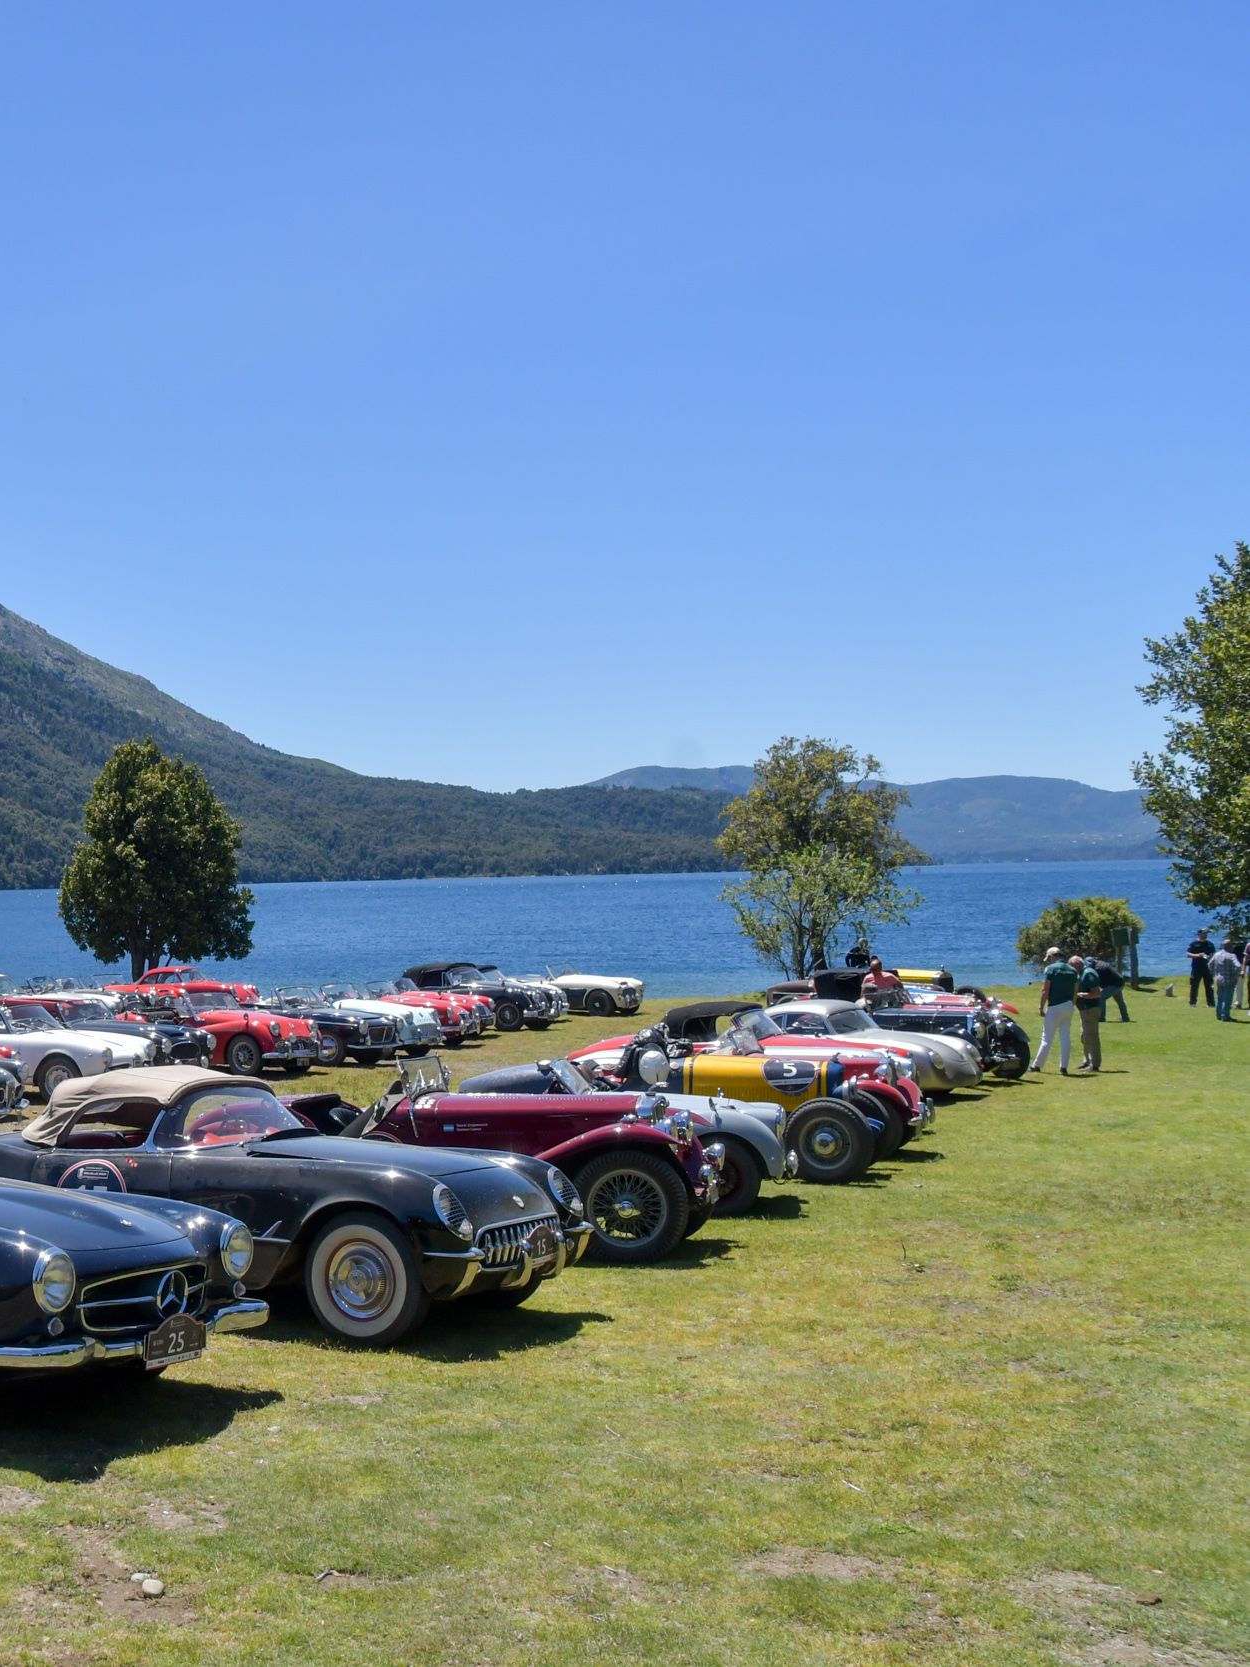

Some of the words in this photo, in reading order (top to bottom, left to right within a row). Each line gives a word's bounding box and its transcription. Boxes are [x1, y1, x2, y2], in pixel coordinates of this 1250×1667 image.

[783, 1062, 798, 1077] 5
[537, 1238, 547, 1255] 15
[168, 1331, 185, 1354] 25
